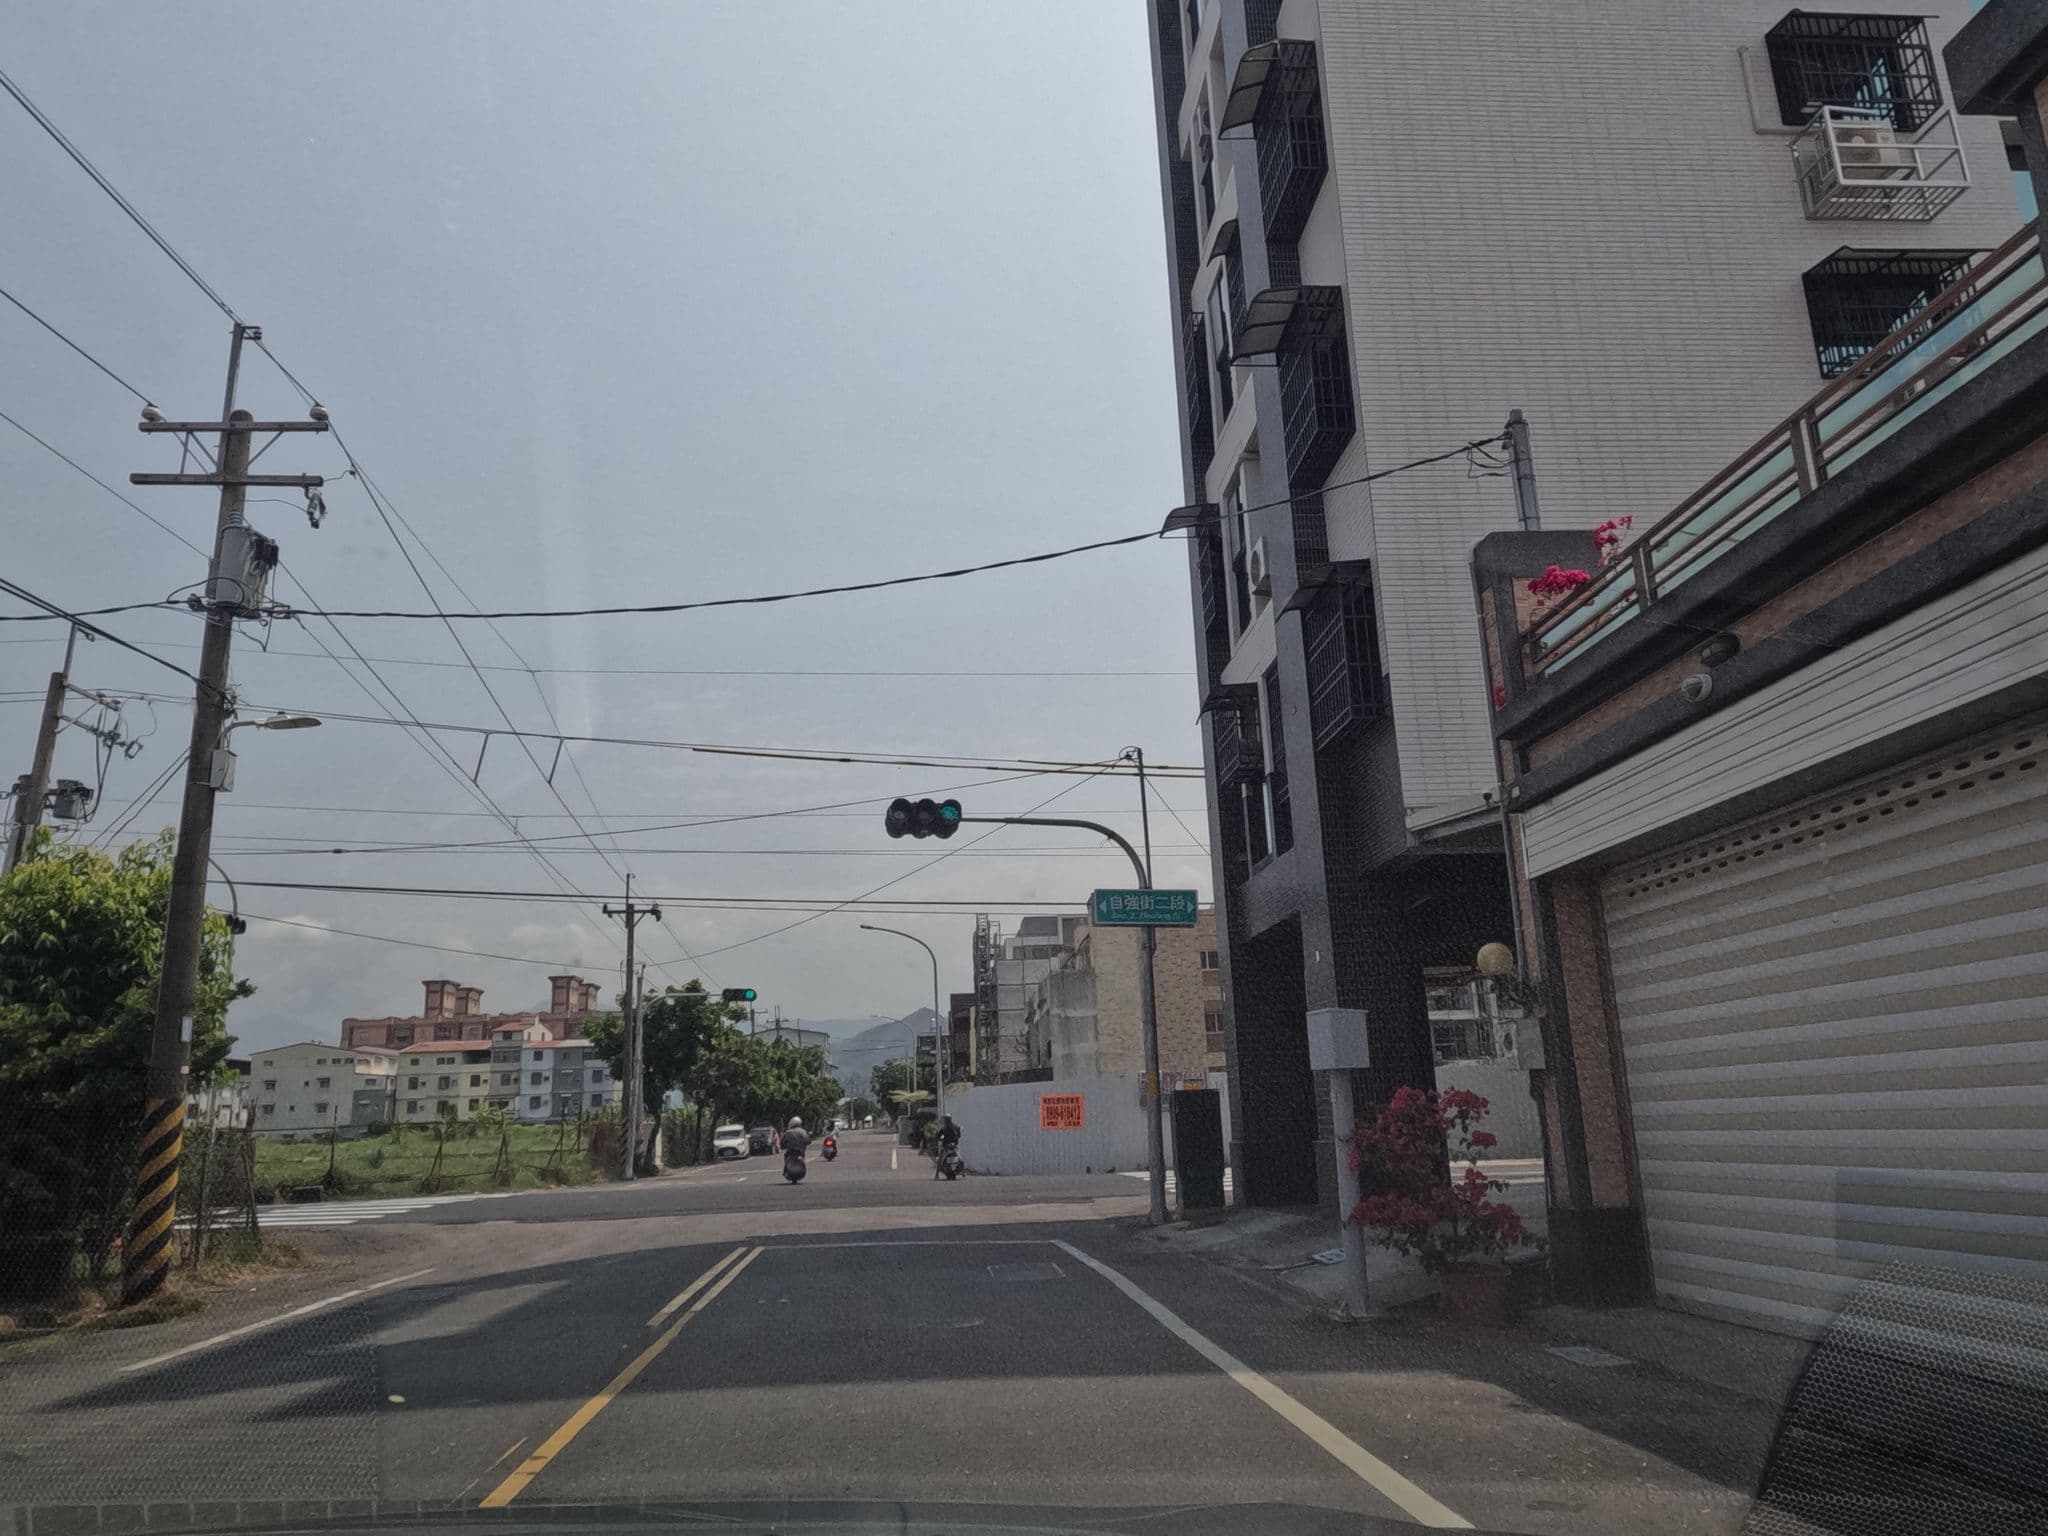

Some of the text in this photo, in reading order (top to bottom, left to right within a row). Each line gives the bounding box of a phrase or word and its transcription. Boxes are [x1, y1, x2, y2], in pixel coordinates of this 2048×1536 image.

[1110, 895, 1184, 910] 自強街二段
